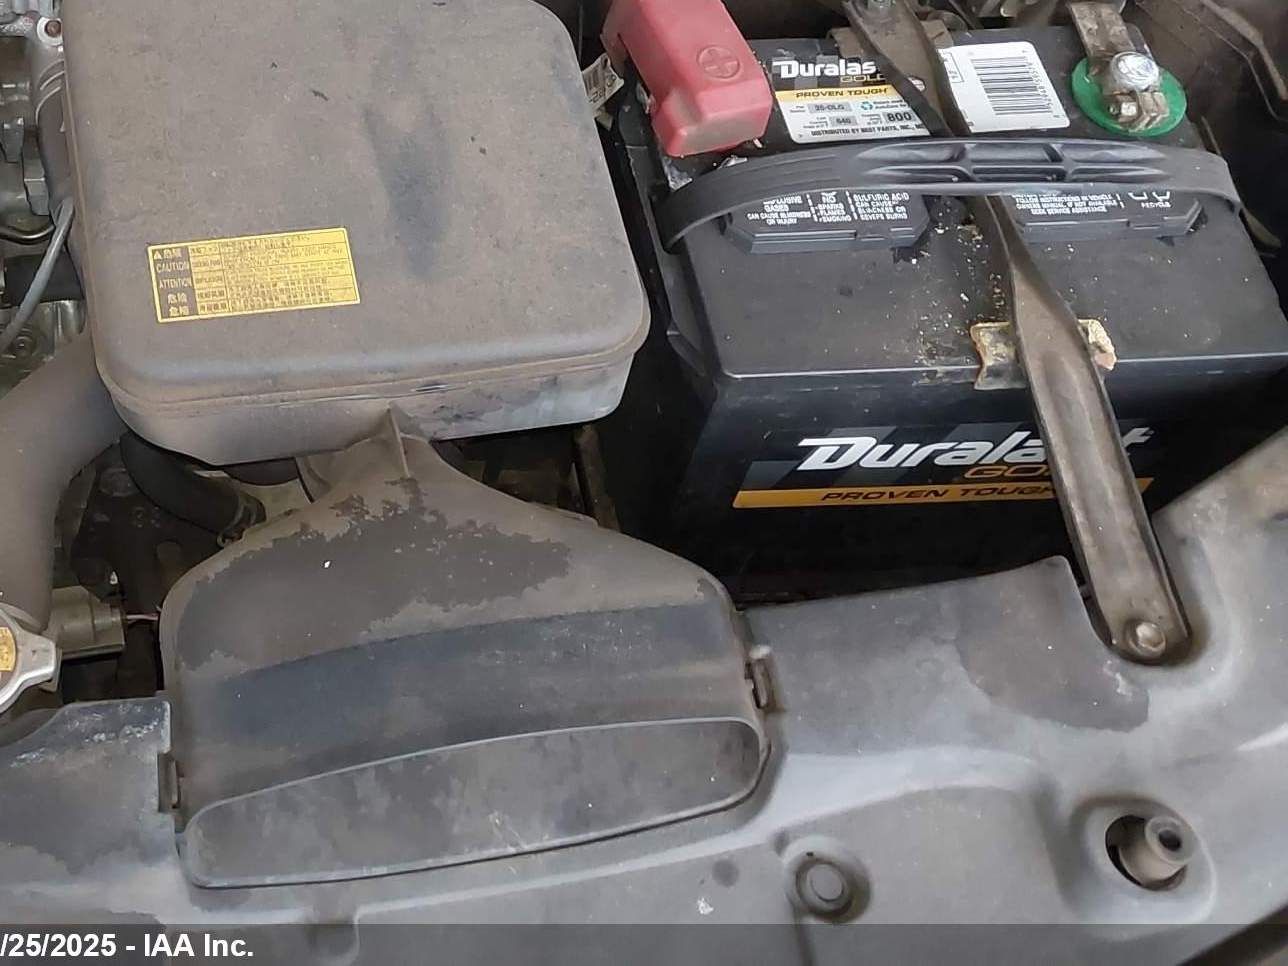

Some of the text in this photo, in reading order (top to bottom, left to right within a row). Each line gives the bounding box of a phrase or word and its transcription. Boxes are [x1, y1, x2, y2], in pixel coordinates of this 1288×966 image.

[772, 59, 877, 79] Duralas
[796, 87, 888, 98] PROVEN TOUGH
[887, 112, 912, 122] 800
[891, 192, 910, 200] ACID
[156, 260, 190, 274] CAUTION
[159, 277, 193, 290] ATTENTION
[796, 427, 1155, 471] Duralat
[822, 489, 949, 501] PROVEN
